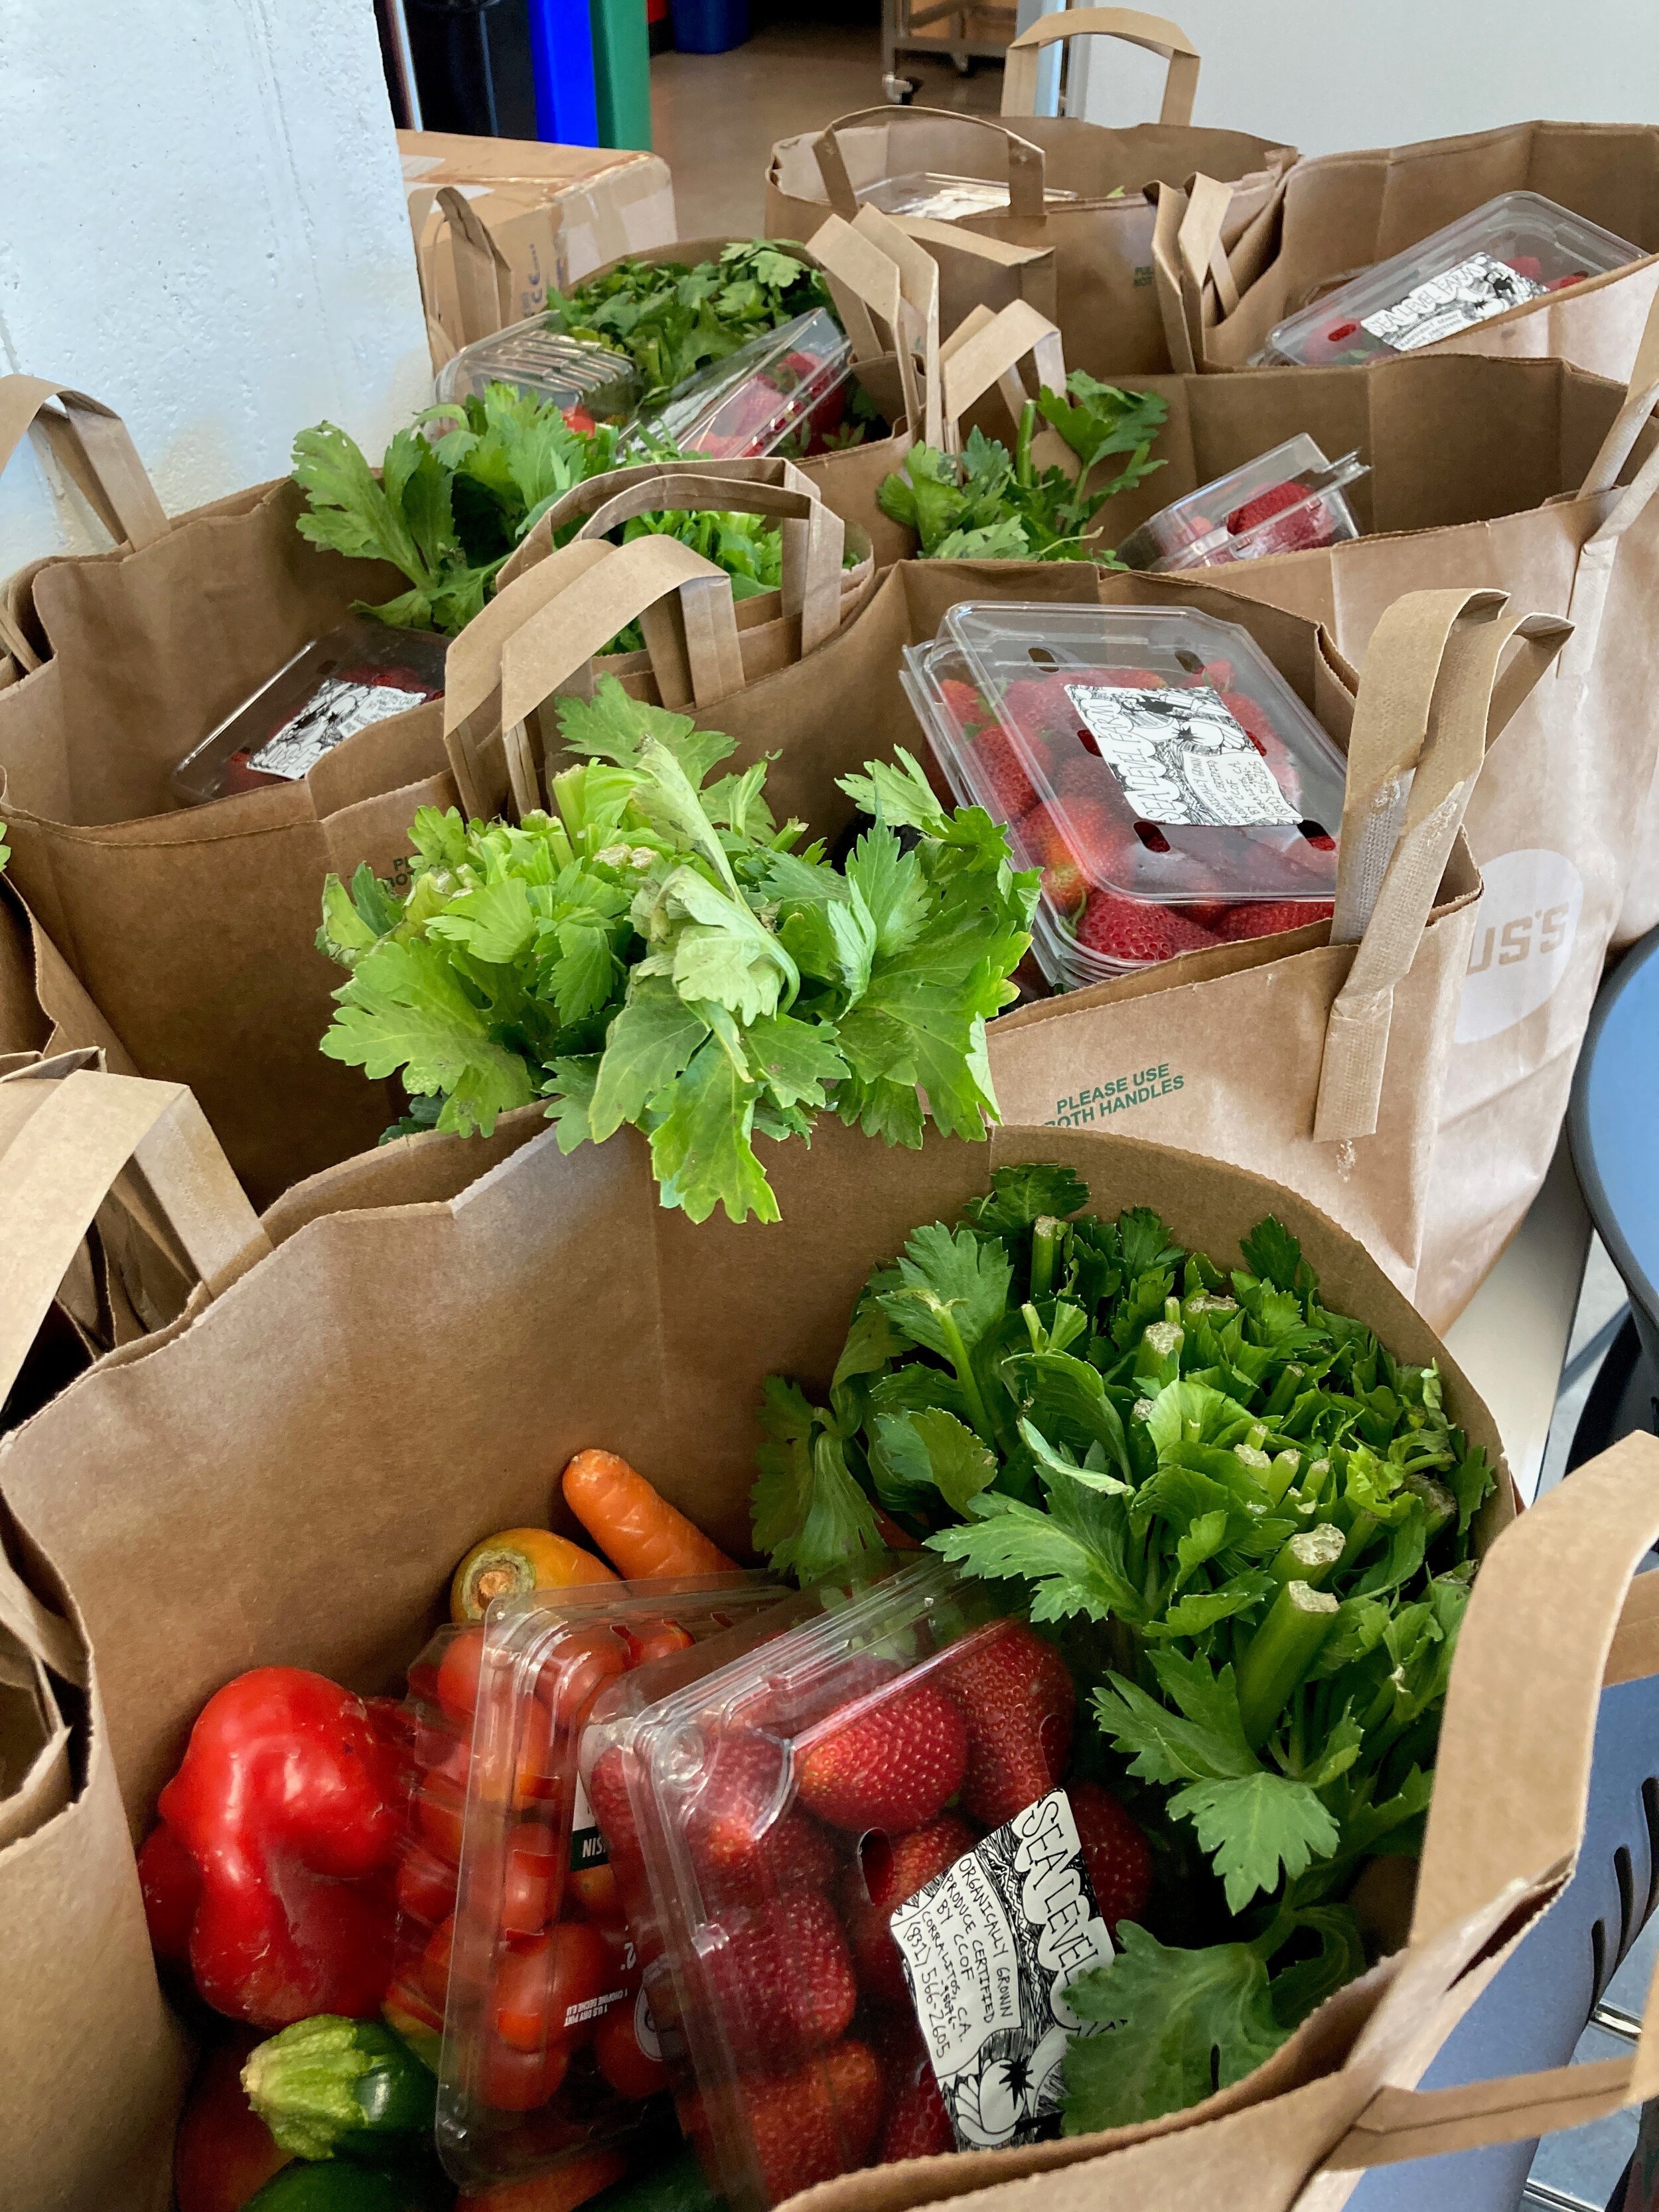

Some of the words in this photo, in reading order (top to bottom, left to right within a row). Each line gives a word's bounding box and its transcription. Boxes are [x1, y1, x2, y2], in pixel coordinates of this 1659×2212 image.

[1090, 704, 1141, 743] FARM
[1112, 749, 1160, 786] LEVEL
[1189, 757, 1205, 777] GROWN
[1206, 760, 1227, 793] CERTIFIED
[1226, 778, 1244, 800] CCOF
[1137, 792, 1181, 821] SEA
[1193, 778, 1240, 824] ORGANICALLY
[1224, 796, 1256, 822] PRODUCE
[1244, 806, 1261, 816] BY
[1465, 901, 1569, 978] US'S
[1056, 1076, 1129, 1114] PLEASE
[1133, 1063, 1170, 1086] USE
[1099, 1074, 1185, 1117] HANDLES
[1021, 1801, 1068, 1891] SEA
[936, 1899, 953, 1925] BY
[954, 1933, 975, 1981] CCOF
[942, 1873, 975, 1935] PRODUCE
[972, 1939, 995, 2024] CERTIFIED
[959, 1857, 1009, 1957] ORGANICALLY
[996, 1966, 1013, 2018] GROWN
[1044, 1878, 1098, 1986] LEVEL
[903, 1921, 931, 1968] (831)
[921, 1967, 950, 2059] 566-2605
